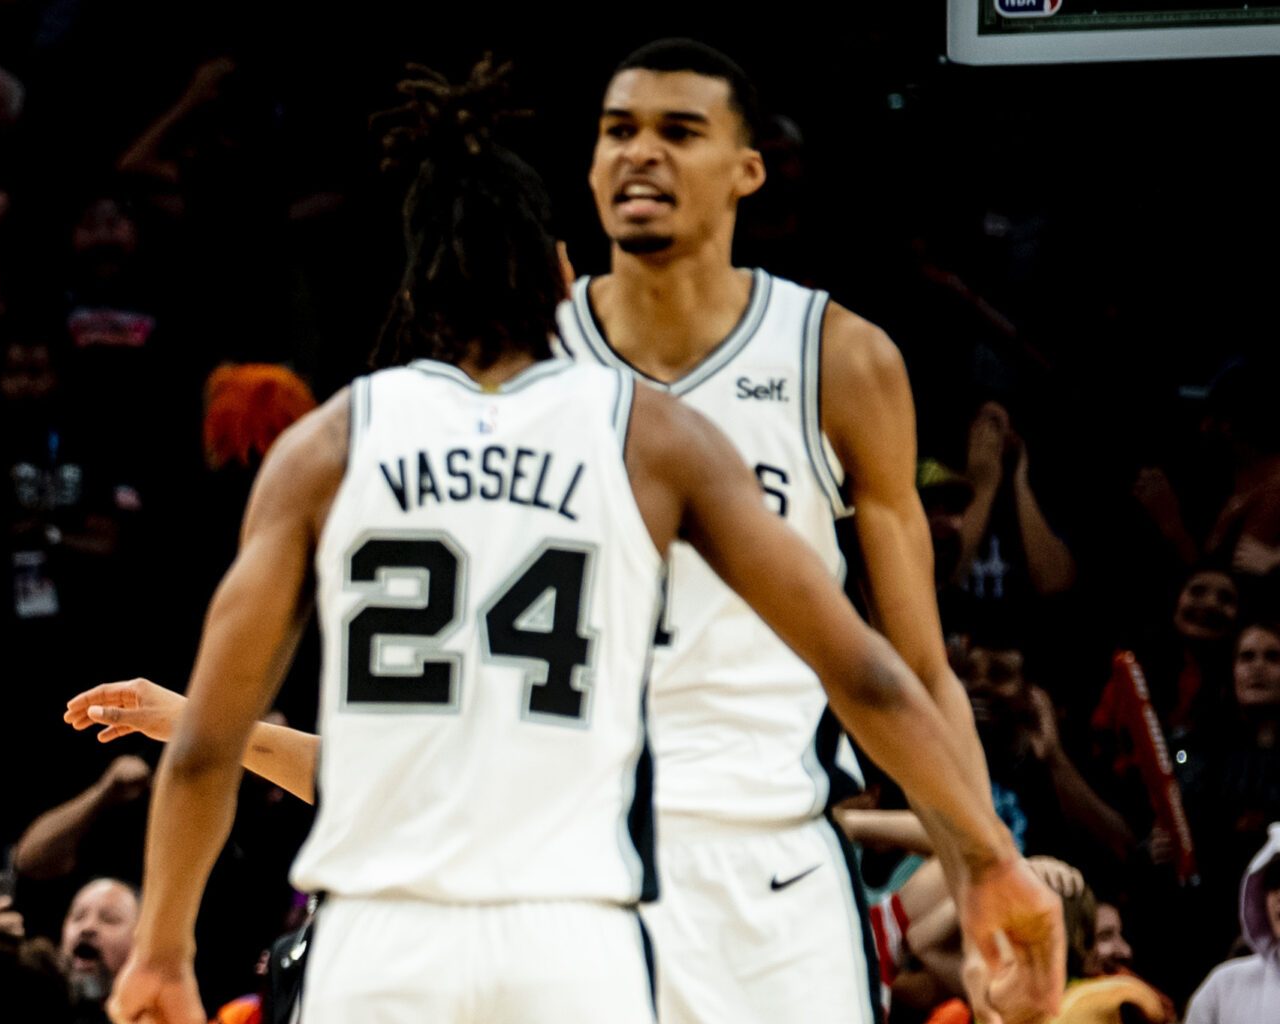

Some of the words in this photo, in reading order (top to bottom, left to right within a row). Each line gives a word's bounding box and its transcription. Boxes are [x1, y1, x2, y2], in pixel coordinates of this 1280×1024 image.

[735, 376, 790, 402] Self.
[379, 445, 584, 521] VASSELL
[340, 530, 600, 729] 24
